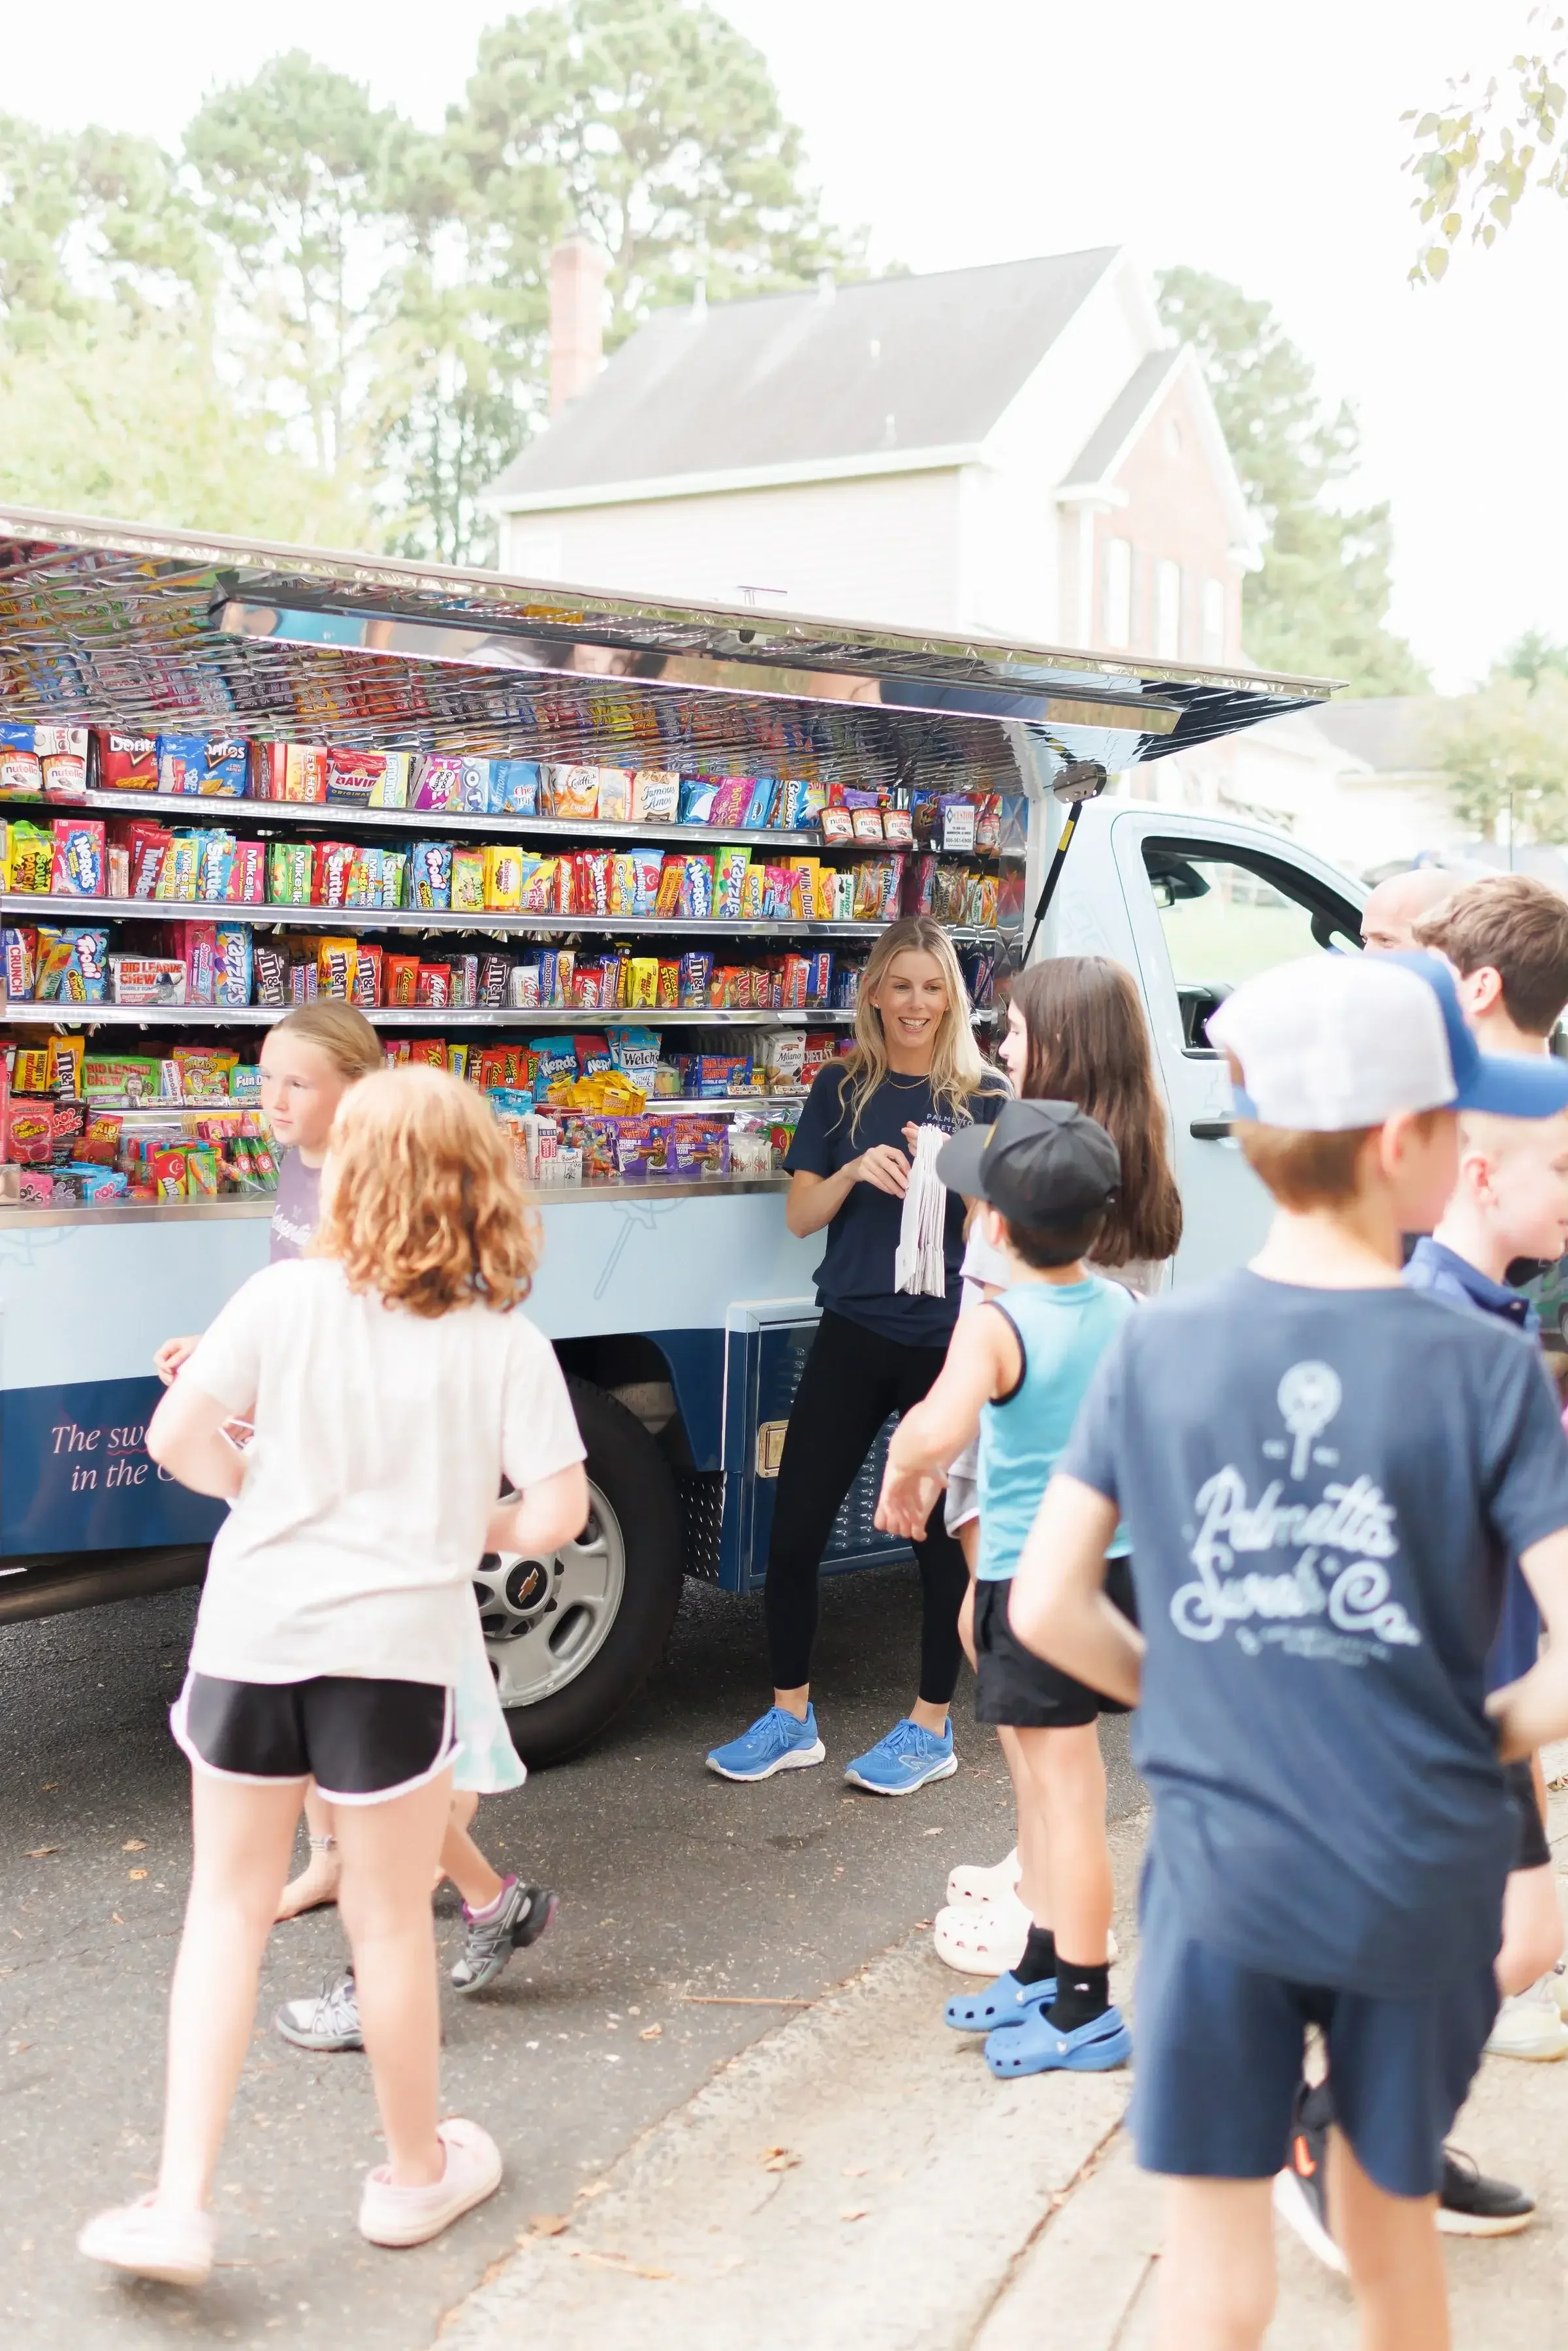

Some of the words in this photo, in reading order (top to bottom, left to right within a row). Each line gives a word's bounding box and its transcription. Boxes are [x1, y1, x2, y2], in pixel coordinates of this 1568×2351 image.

[6, 765, 37, 775] nutella
[52, 770, 84, 778] nutella
[641, 784, 675, 801] Famous
[643, 797, 672, 810] Amos
[74, 836, 96, 888] Nerds
[425, 848, 447, 889] Trolli
[633, 858, 646, 901] AIRHEADS
[689, 863, 707, 917] Nerds
[881, 871, 890, 907] HARIBO
[844, 878, 853, 916] Junior
[76, 934, 102, 979] Trolli
[120, 962, 140, 972] BIG
[10, 946, 22, 993] CRUNCH
[120, 974, 156, 984] CHEW
[226, 933, 246, 1004] Razzles
[819, 955, 829, 996] CRUNCH
[401, 967, 414, 1003] Reese's
[618, 967, 627, 998] AVENUE
[661, 968, 674, 1001] STICKS
[541, 1056, 577, 1077] Nerds
[624, 1052, 660, 1066] Welch's
[702, 1059, 716, 1068] BIG
[776, 1053, 801, 1063] Milano
[87, 1075, 122, 1085] CHEW
[236, 1076, 256, 1088] Fun
[702, 1068, 728, 1078] CHEW
[927, 1113, 973, 1127] PALMETTO
[620, 1128, 650, 1138] CHEW
[675, 1133, 702, 1143] CHEW
[52, 1424, 101, 1454] The
[71, 1465, 97, 1492] in
[106, 1458, 149, 1488] the
